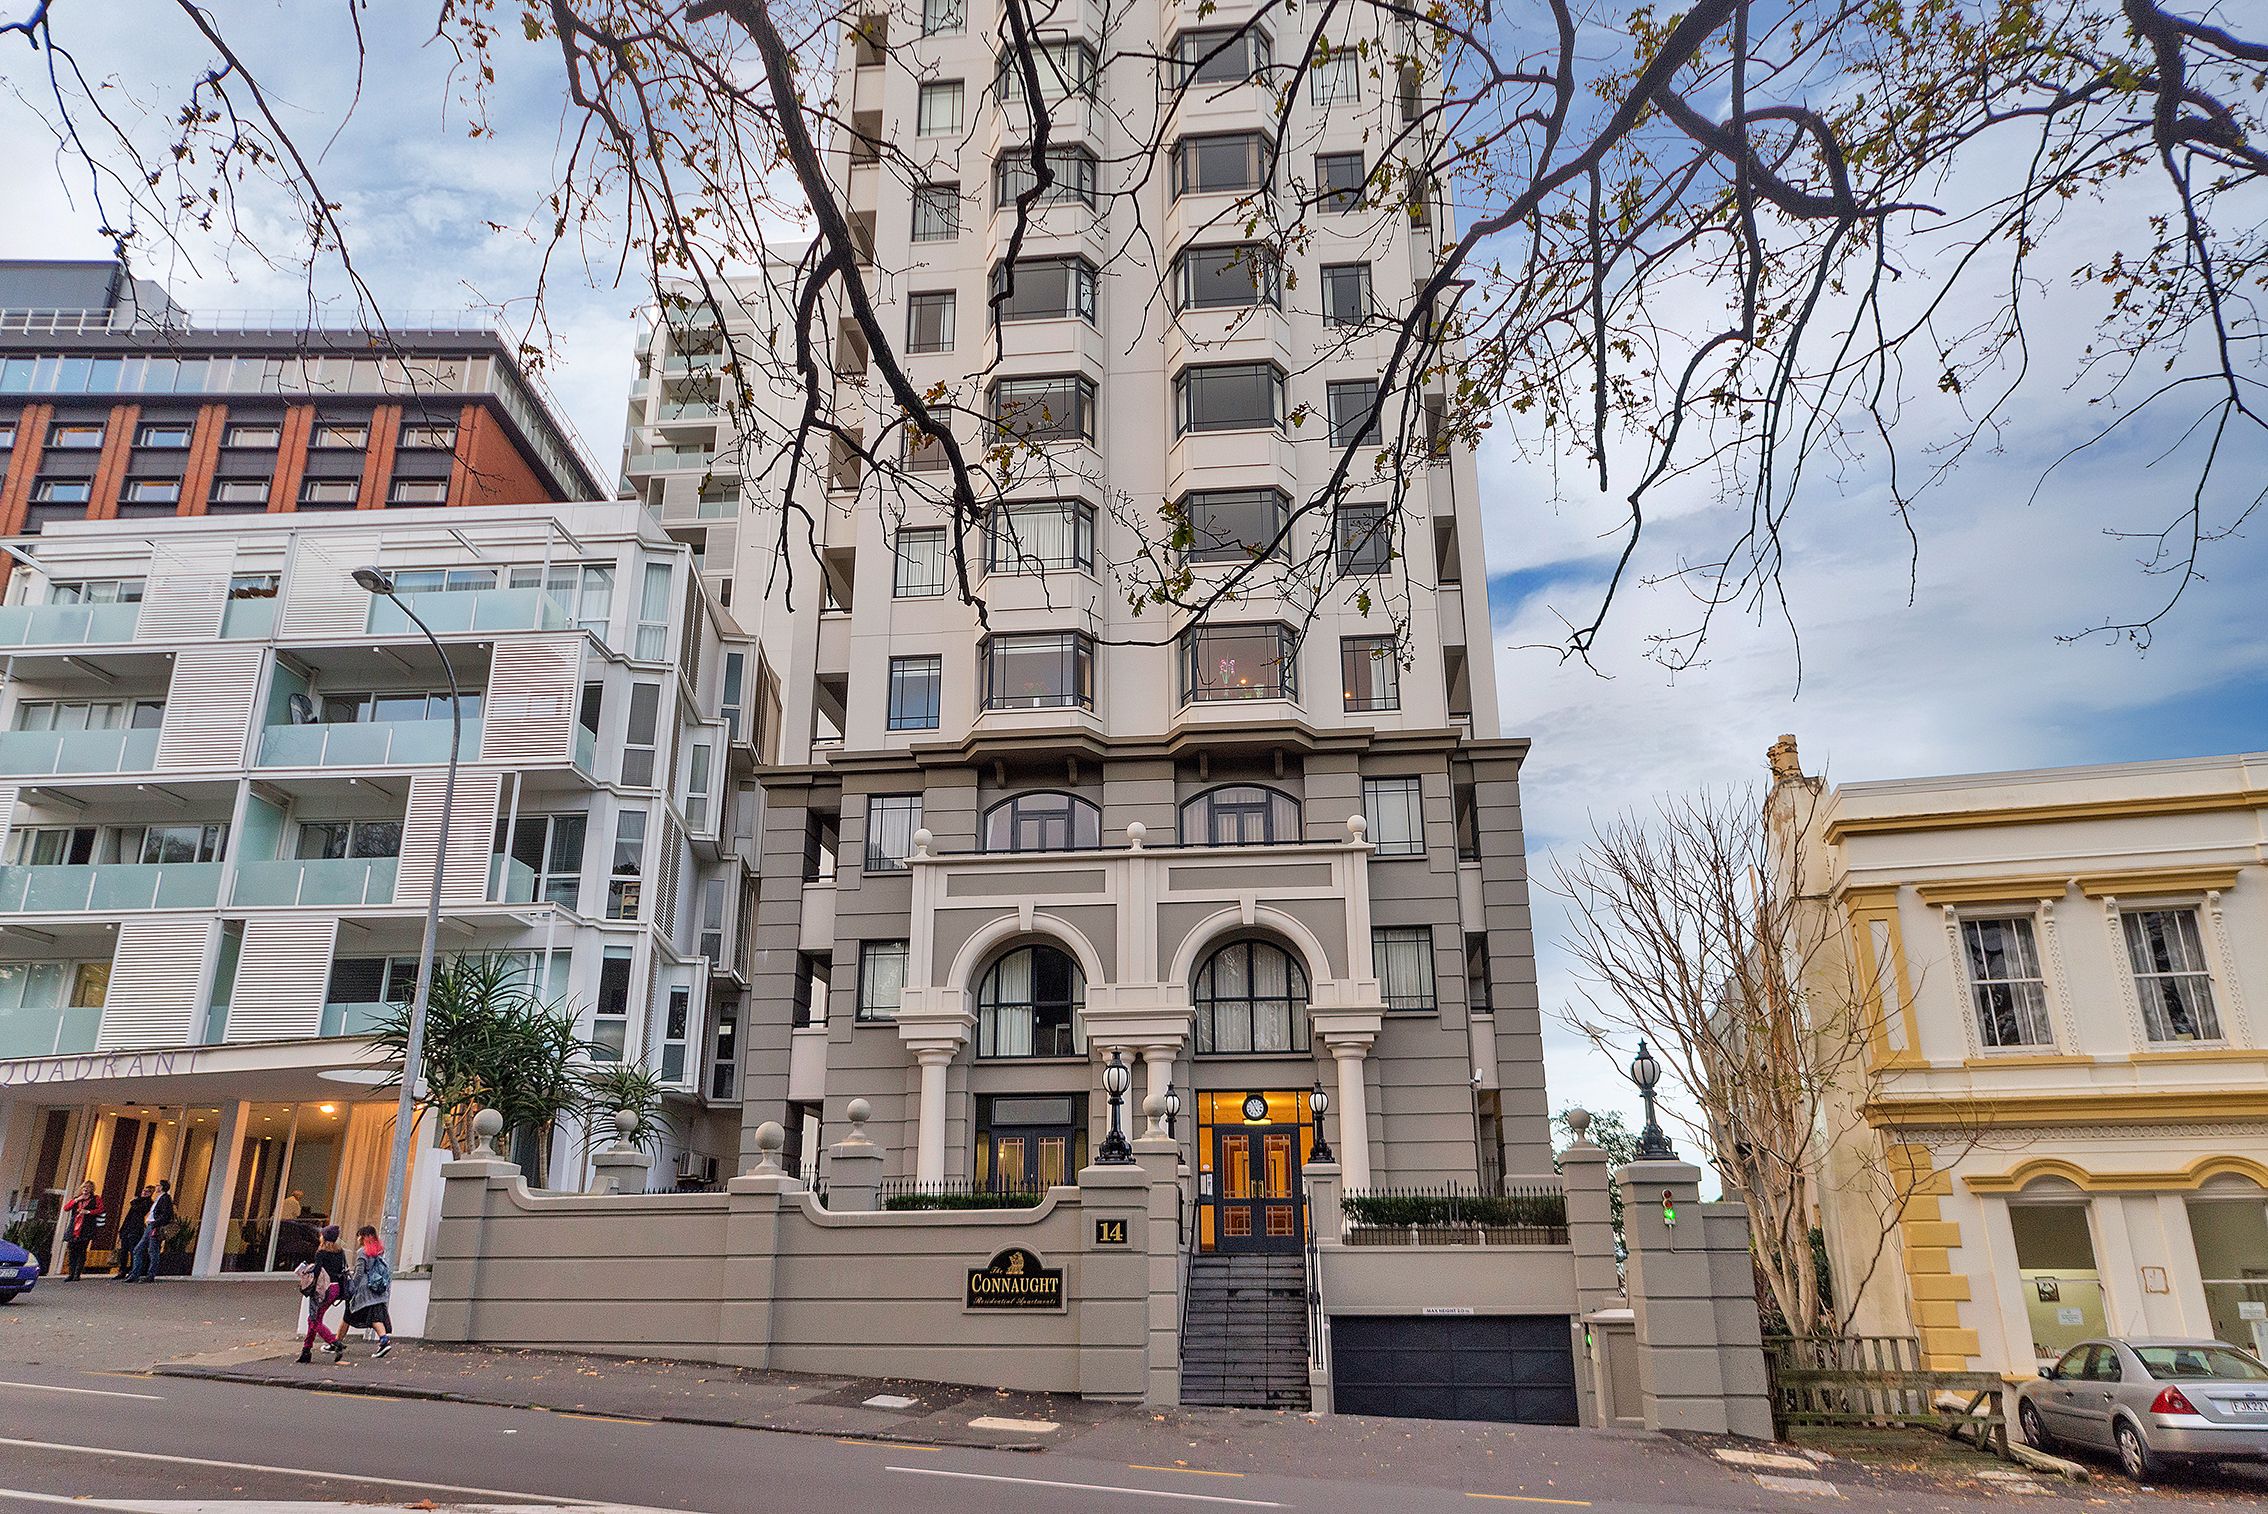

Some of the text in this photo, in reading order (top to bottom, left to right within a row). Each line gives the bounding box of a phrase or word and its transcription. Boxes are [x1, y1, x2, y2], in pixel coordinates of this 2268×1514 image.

[1100, 1222, 1123, 1241] 14
[990, 1266, 1003, 1274] The
[971, 1273, 1059, 1293] CONNAUGHT
